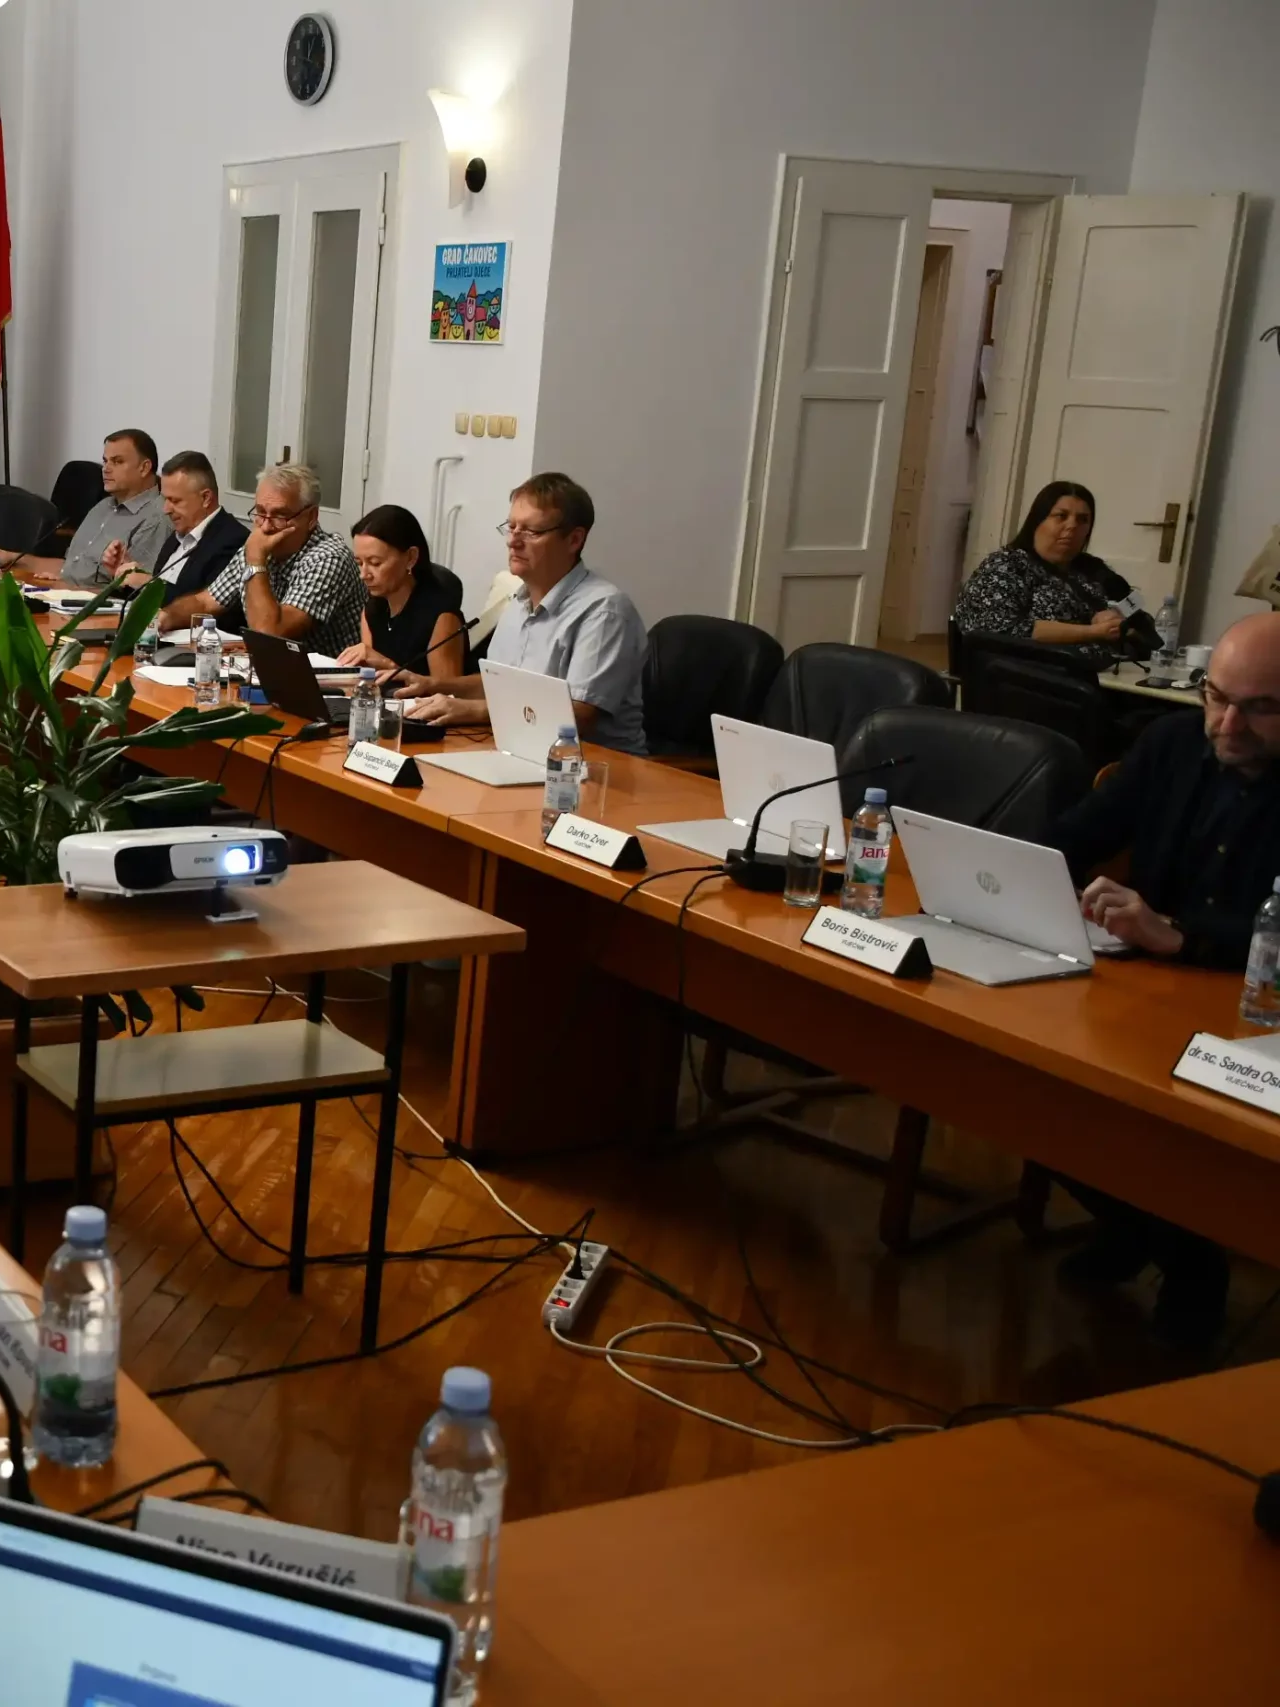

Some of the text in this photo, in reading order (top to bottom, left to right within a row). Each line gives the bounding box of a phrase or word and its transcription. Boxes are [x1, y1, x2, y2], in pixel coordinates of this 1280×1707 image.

[442, 244, 498, 266] GRAD ČAKOVEC
[446, 266, 491, 278] PRIJATELJ DJECE
[566, 825, 609, 847] Darko Zver
[859, 846, 890, 859] Jana
[821, 917, 898, 952] Boris Bistrović
[1219, 1056, 1260, 1079] Sandra
[1261, 1071, 1280, 1089] Os
